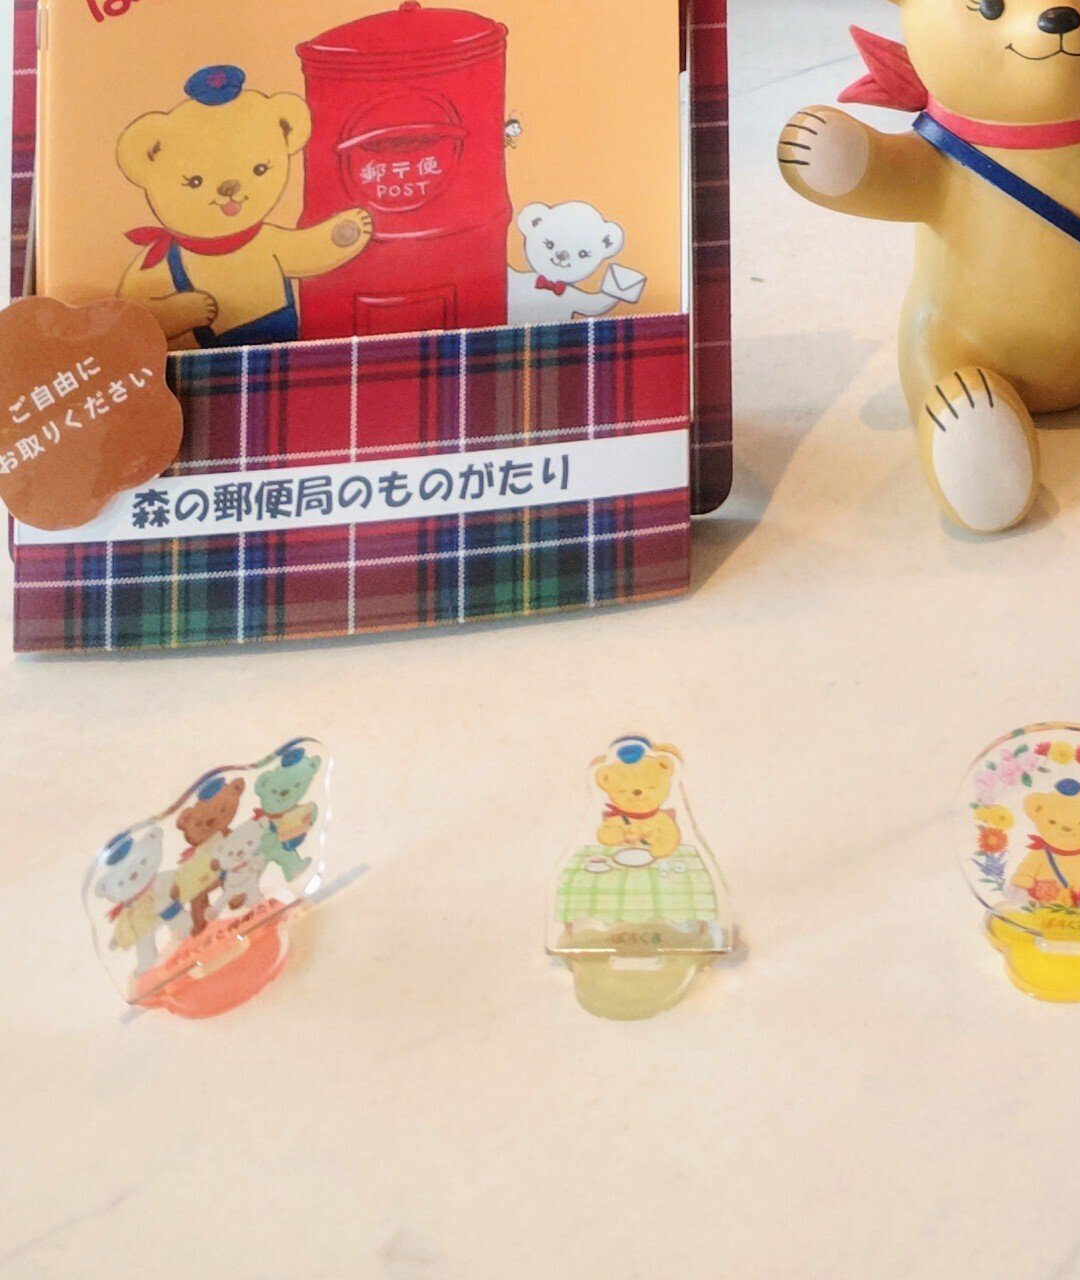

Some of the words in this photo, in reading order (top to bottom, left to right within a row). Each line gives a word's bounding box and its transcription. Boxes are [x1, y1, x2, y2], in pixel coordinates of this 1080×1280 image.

[376, 181, 430, 198] POST
[0, 367, 153, 474] お取りください
[9, 356, 101, 423] ご自由に
[132, 455, 571, 528] 森の郵便局のものがたり
